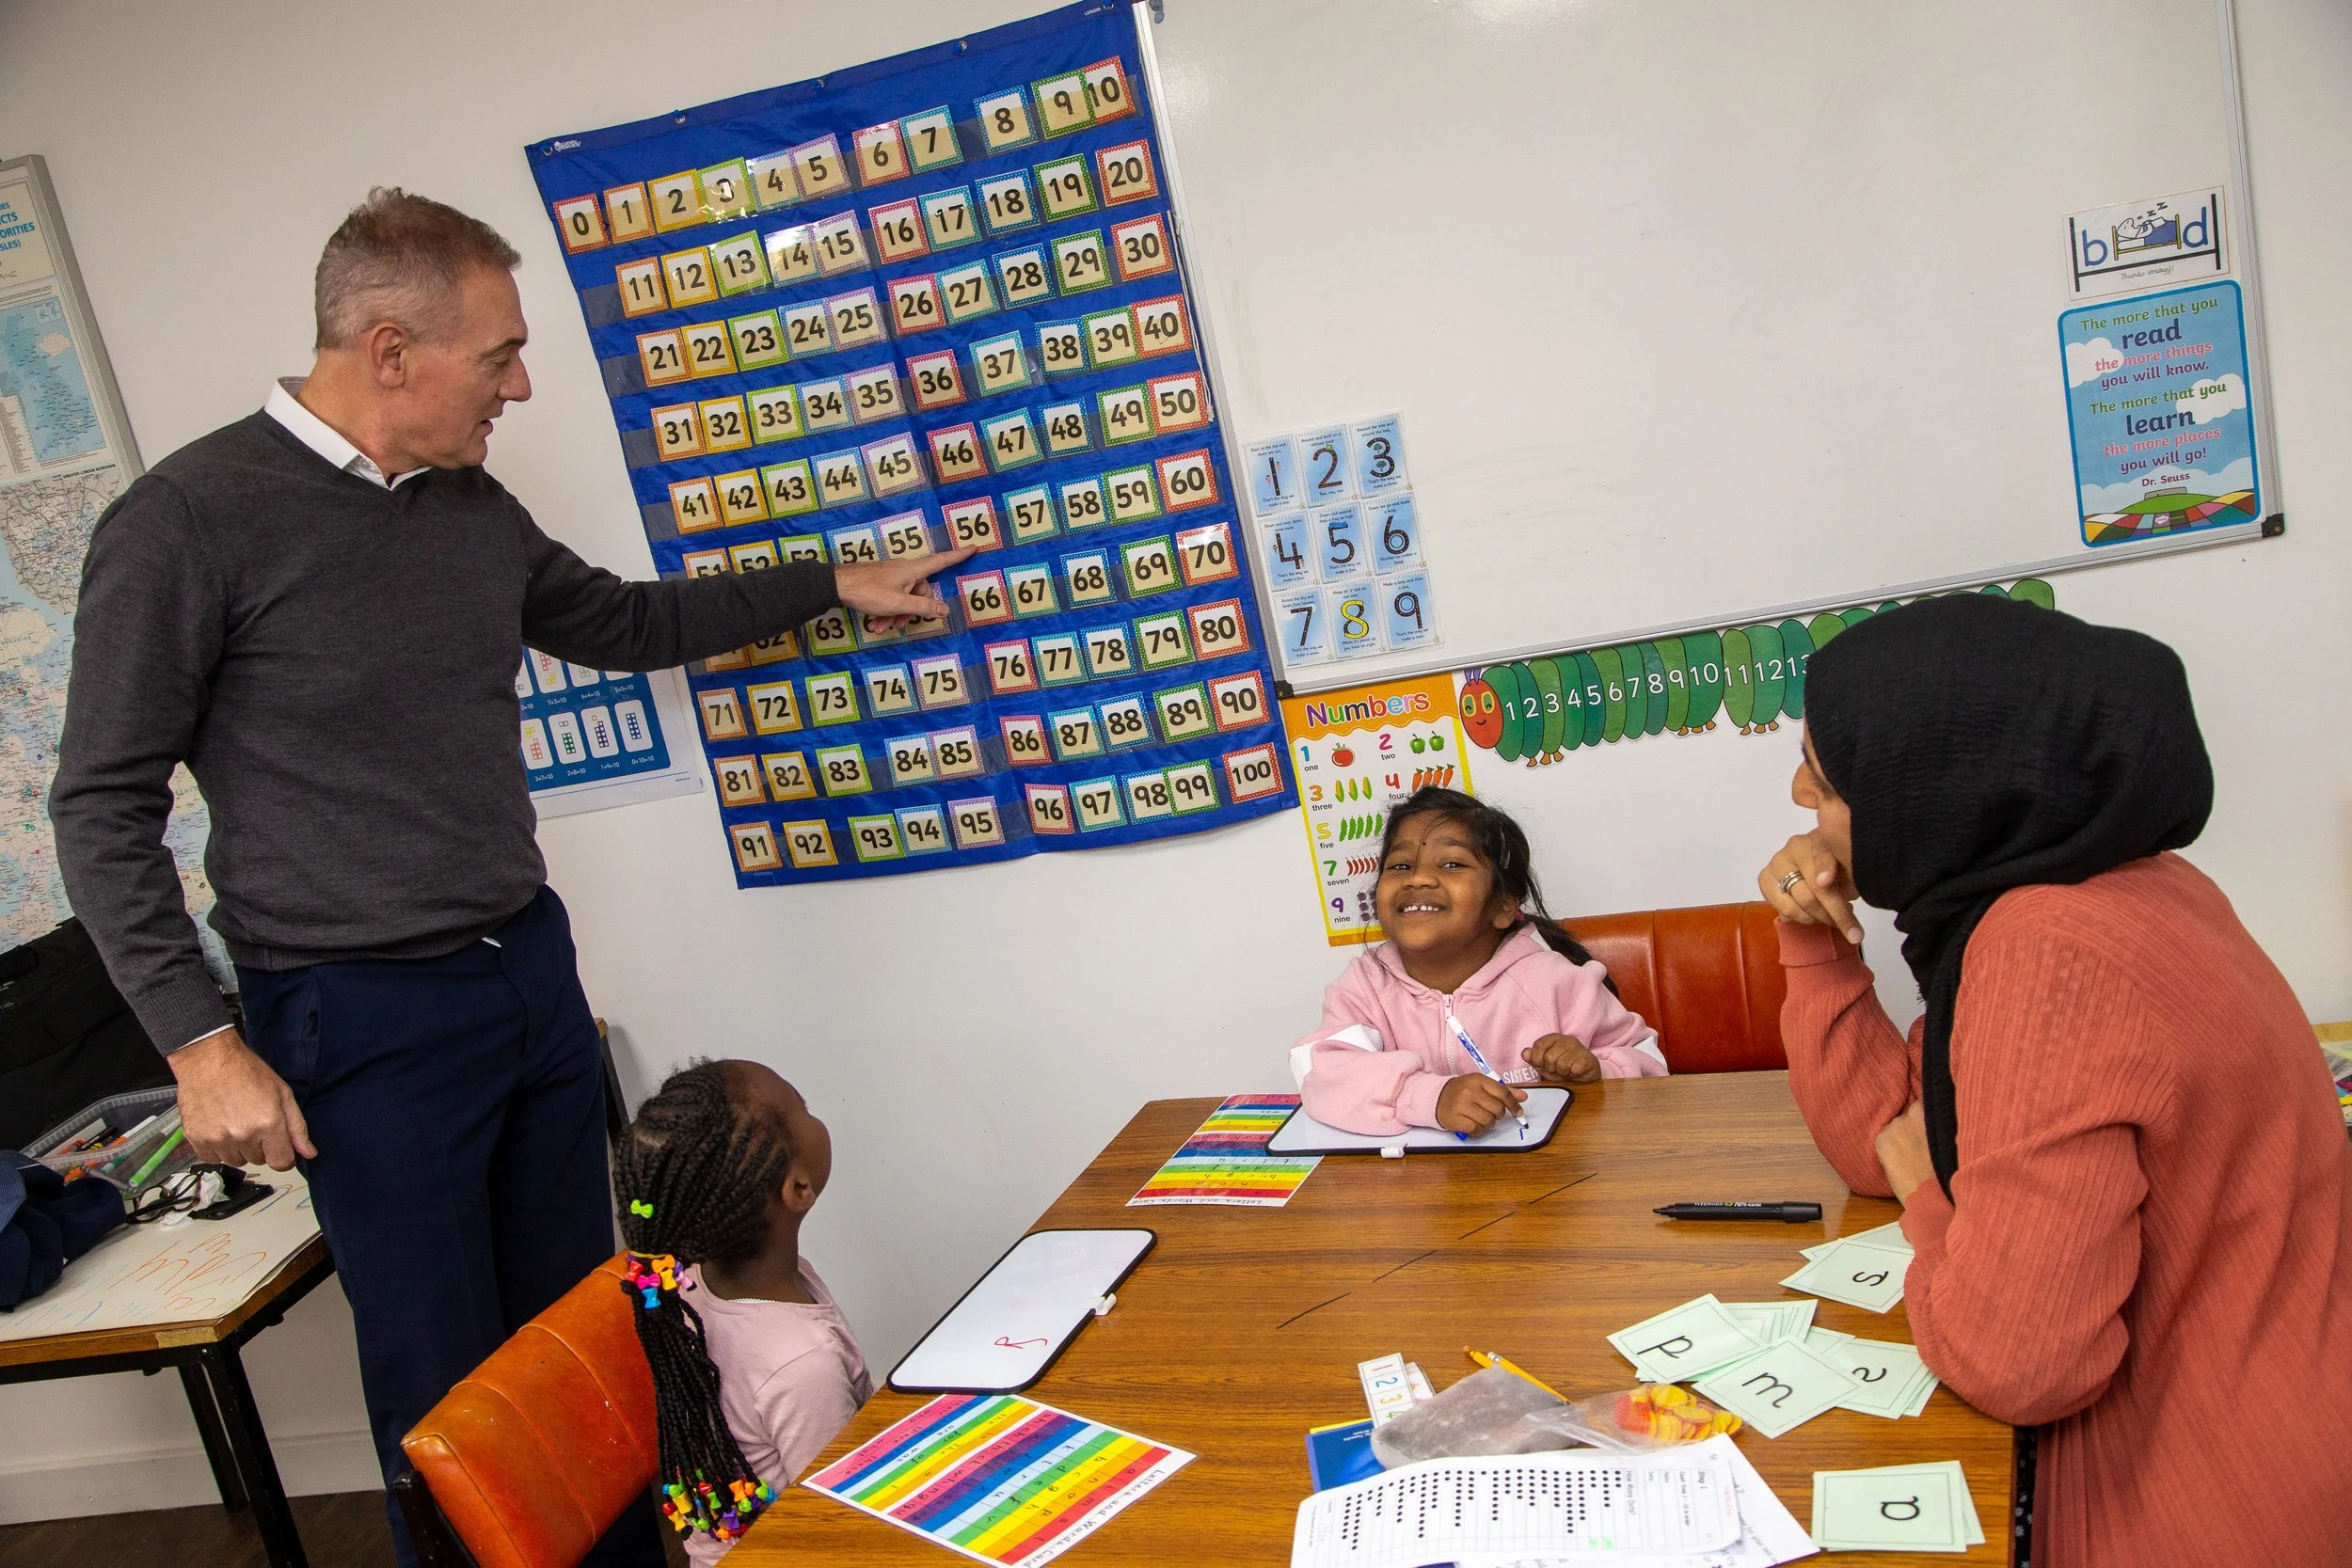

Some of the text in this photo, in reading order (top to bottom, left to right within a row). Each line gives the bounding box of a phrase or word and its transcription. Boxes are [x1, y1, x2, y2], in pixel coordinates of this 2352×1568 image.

[573, 91, 1073, 235] 0 1 2 5 6 7 8 9
[0, 212, 18, 225] CTS
[629, 158, 1142, 300] 11 13 15 16 18 19 20
[2082, 207, 2208, 266] b d
[2148, 265, 2174, 277] strategy!
[650, 233, 1159, 370] 21 22 23 24 25 26 27 28 29 30
[2081, 298, 2218, 331] The more that you
[2122, 318, 2182, 350] read
[2094, 341, 2213, 372] the more things
[2101, 361, 2209, 391] you will know.
[2090, 384, 2227, 415] The more that you
[2126, 410, 2195, 436] learn
[683, 389, 1195, 516] 41 42 43 44 45 46 47 48 49 50
[2104, 428, 2221, 456] the more places
[1269, 437, 1395, 496] 1 2 3
[2121, 447, 2206, 474] you will go!
[2142, 472, 2190, 486] Dr. Seuss
[889, 467, 1204, 554] 55 56 57 58 59 60
[1276, 515, 1409, 569] 4 5 6
[971, 542, 1224, 611] 66 67 68 69 70
[1290, 592, 1422, 646] 7 8 9
[548, 697, 566, 705] 7+3=10
[580, 690, 600, 700] 6+4=10
[614, 684, 634, 693] 5+5=10
[1505, 701, 1515, 721] 1
[1523, 698, 1539, 718] 2
[1545, 692, 1560, 713] 3
[1566, 689, 1582, 708] 4
[1586, 684, 1602, 705] 5
[1608, 680, 1623, 702] 6
[1627, 676, 1640, 698] 7
[1647, 673, 1664, 694] 8
[1669, 669, 1685, 689] 9
[1690, 662, 1719, 687] 10
[1724, 663, 1749, 688] 11
[1754, 658, 1785, 683] 12
[1305, 692, 1430, 728] Numbers
[725, 689, 1256, 792] 81 82 83 84 85 86 87 88 89 90
[1300, 734, 1393, 762] 1 2
[566, 768, 586, 776] 2+8=10
[600, 762, 620, 770] 1+9=10
[631, 755, 655, 765] 0+10=10
[1304, 764, 1319, 772] one
[534, 773, 553, 782] 3+7=10
[1310, 772, 1399, 801] 3 4
[741, 761, 1270, 858] 91 92 93 94 95 96 97 98 99 100
[1312, 802, 1333, 812] three
[1316, 823, 1331, 840] 5
[1319, 841, 1334, 849] five
[1323, 861, 1337, 877] 7
[1327, 878, 1350, 886] seven
[1331, 897, 1344, 913] 9
[1334, 914, 1351, 923] nine
[1852, 1270, 1889, 1287] s
[1637, 1335, 1693, 1359] p
[1741, 1370, 1793, 1409] m
[1124, 1468, 1165, 1497] Letters
[1098, 1498, 1119, 1516] and
[1881, 1496, 1920, 1522] a
[1057, 1518, 1096, 1544] Words
